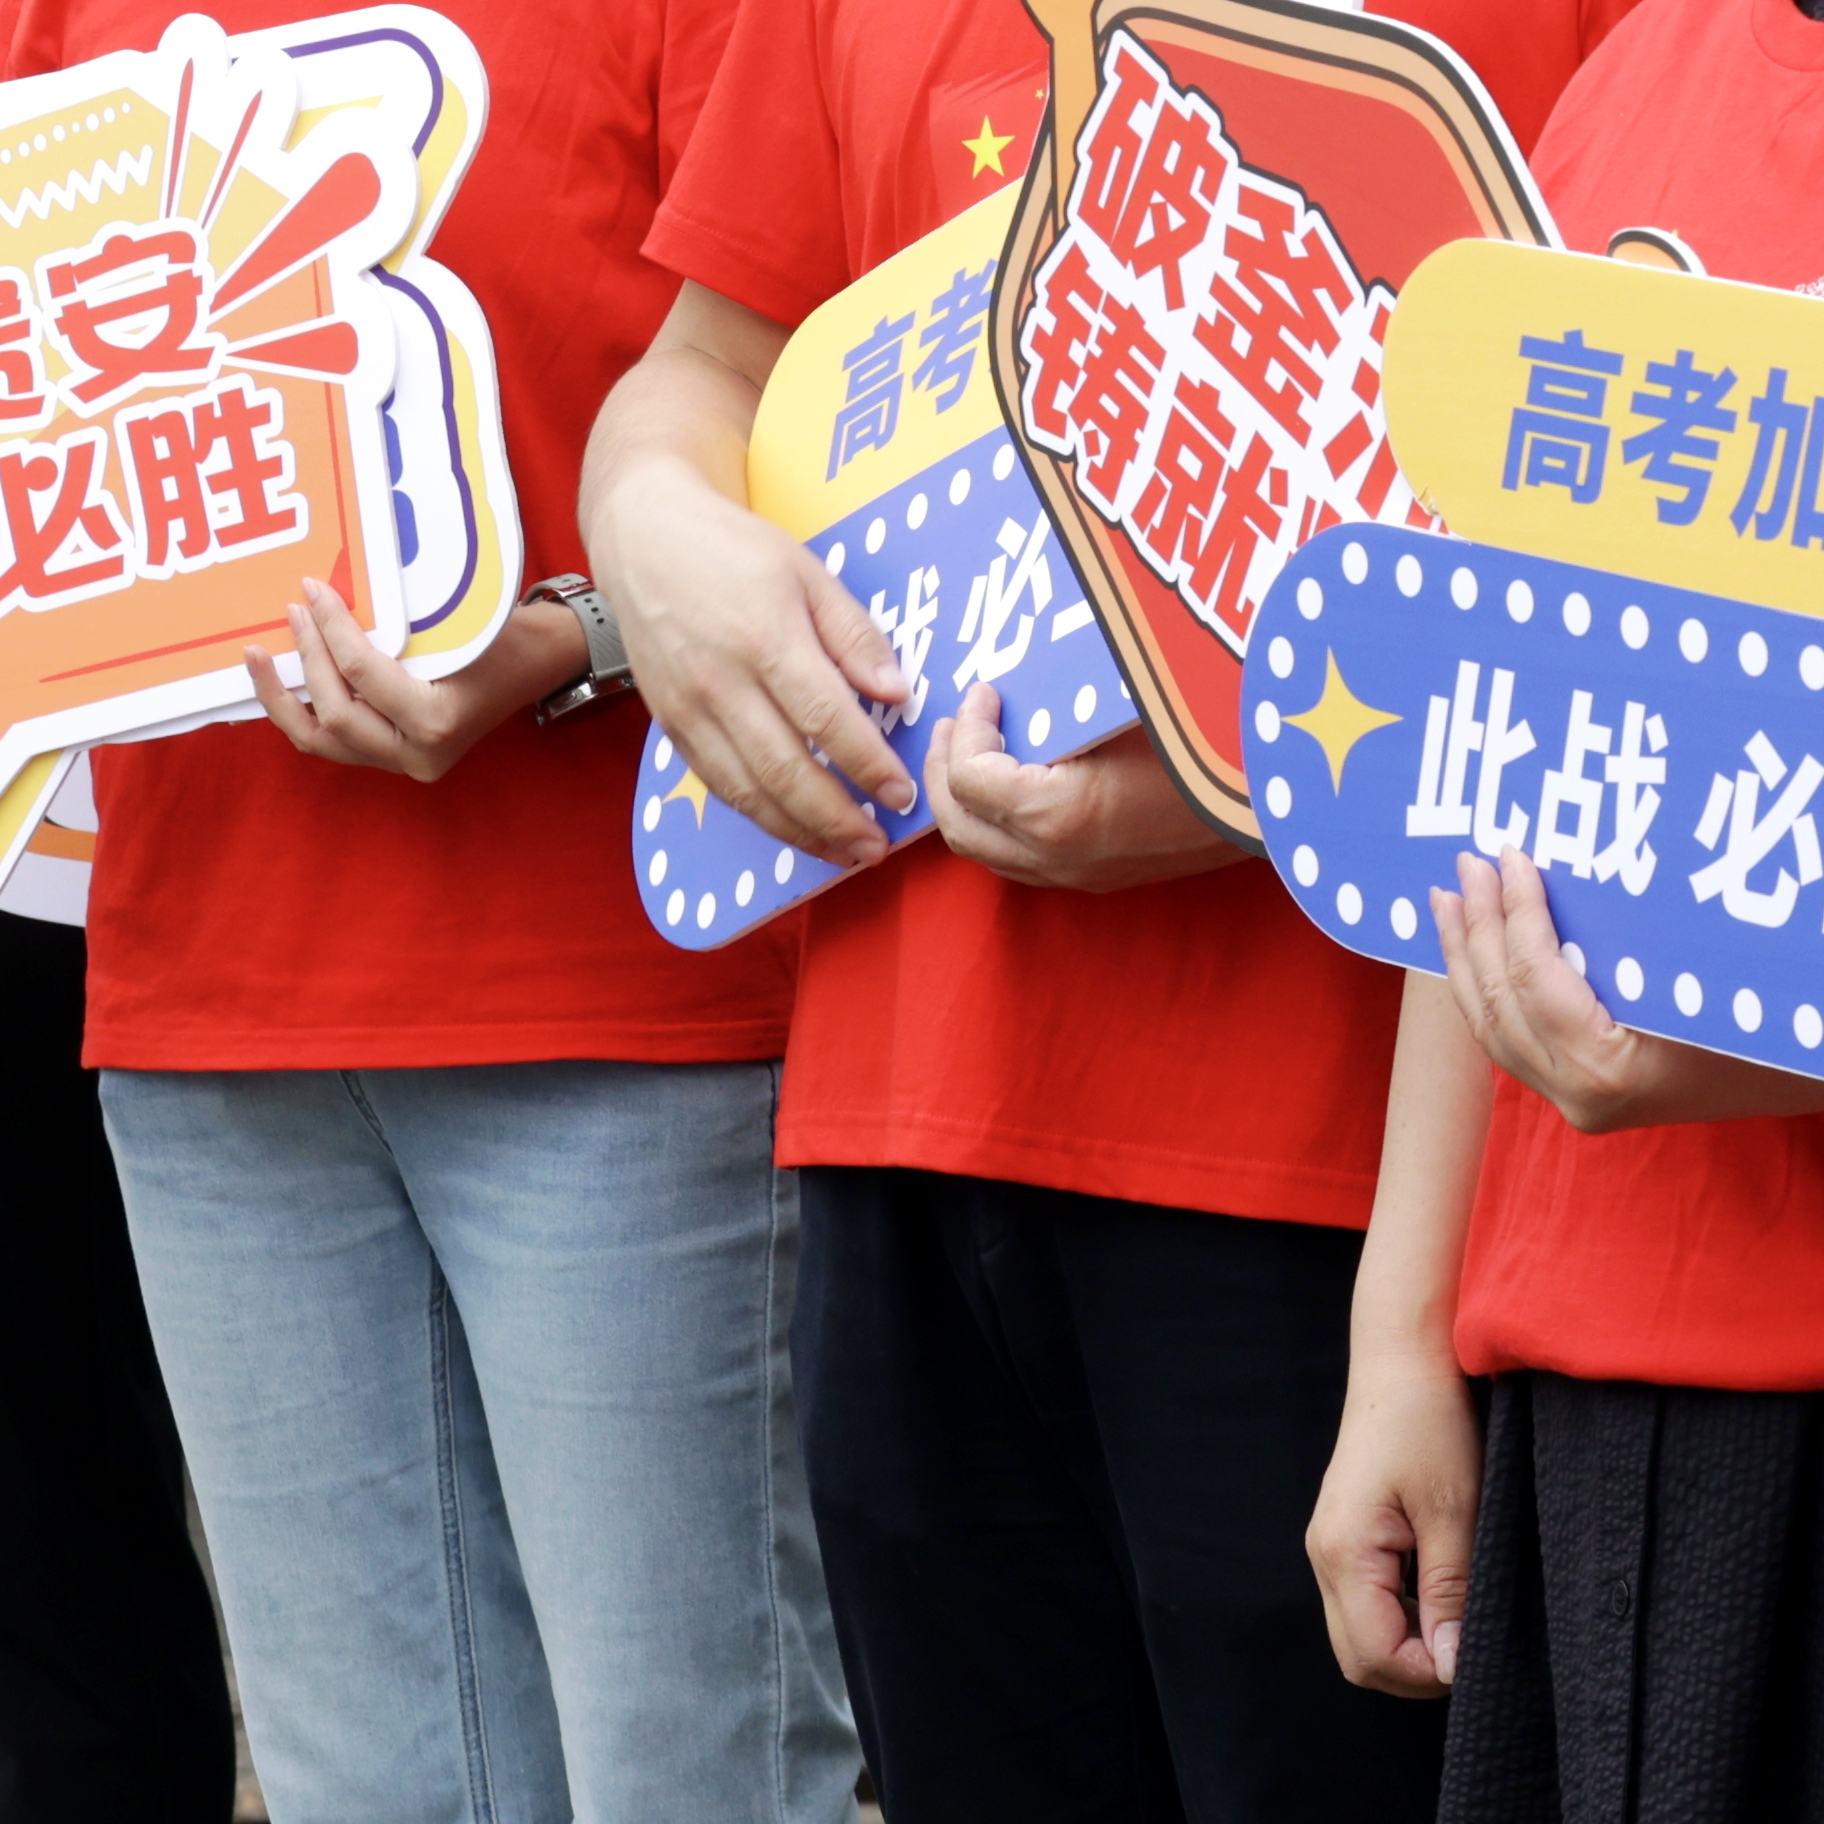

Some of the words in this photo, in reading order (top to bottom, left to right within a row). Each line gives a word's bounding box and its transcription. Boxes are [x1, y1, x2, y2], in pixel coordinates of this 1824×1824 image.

[824, 258, 999, 484] 高考
[1028, 240, 1343, 643] 铸就
[951, 507, 1096, 693] 必
